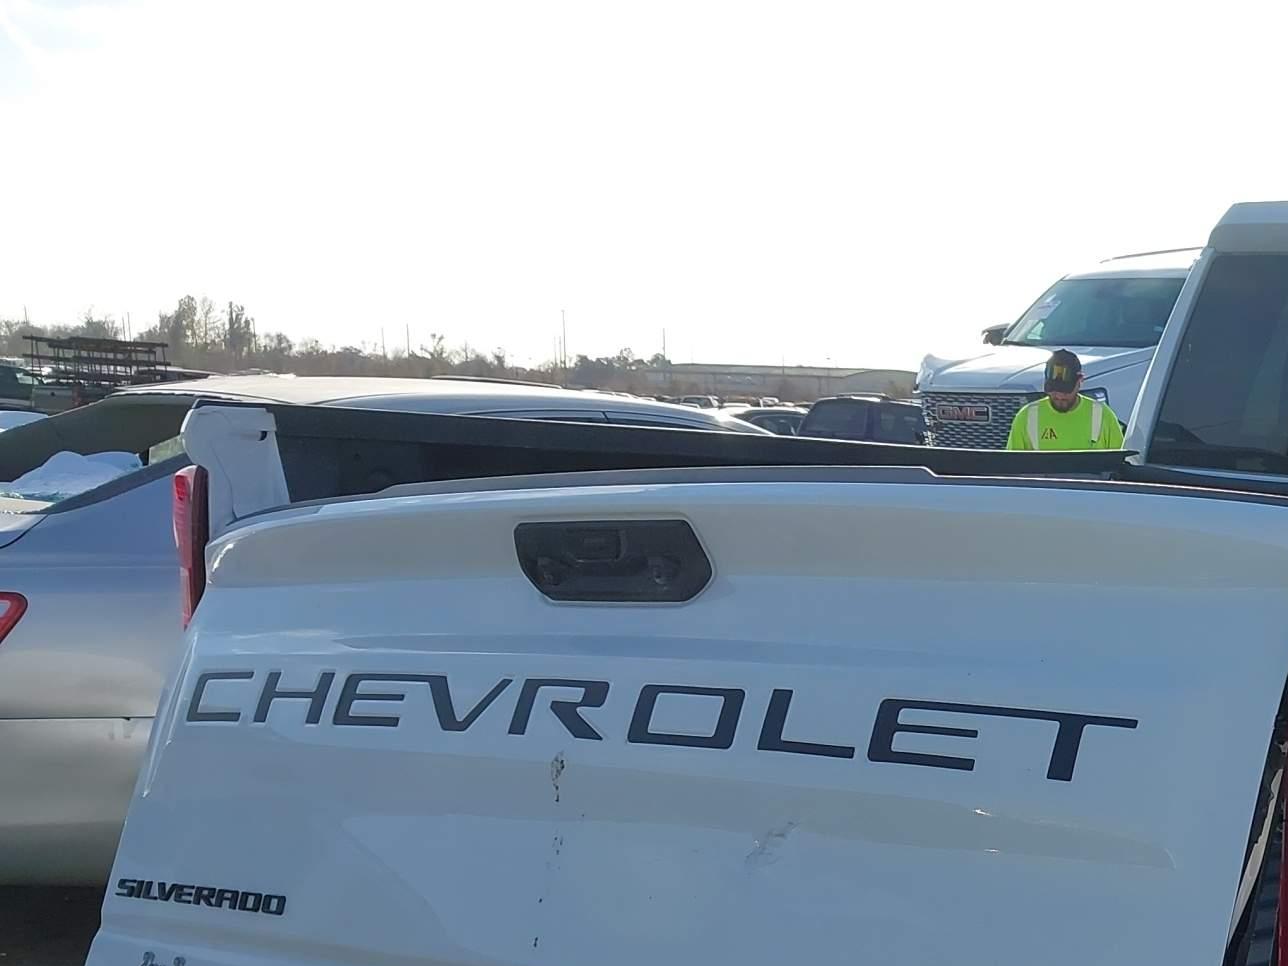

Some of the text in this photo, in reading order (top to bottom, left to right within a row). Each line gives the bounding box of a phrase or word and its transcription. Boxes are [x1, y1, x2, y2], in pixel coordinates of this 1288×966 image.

[938, 405, 988, 422] GMC
[186, 671, 1139, 782] CHEVROLET
[115, 878, 287, 916] SILVERADO
